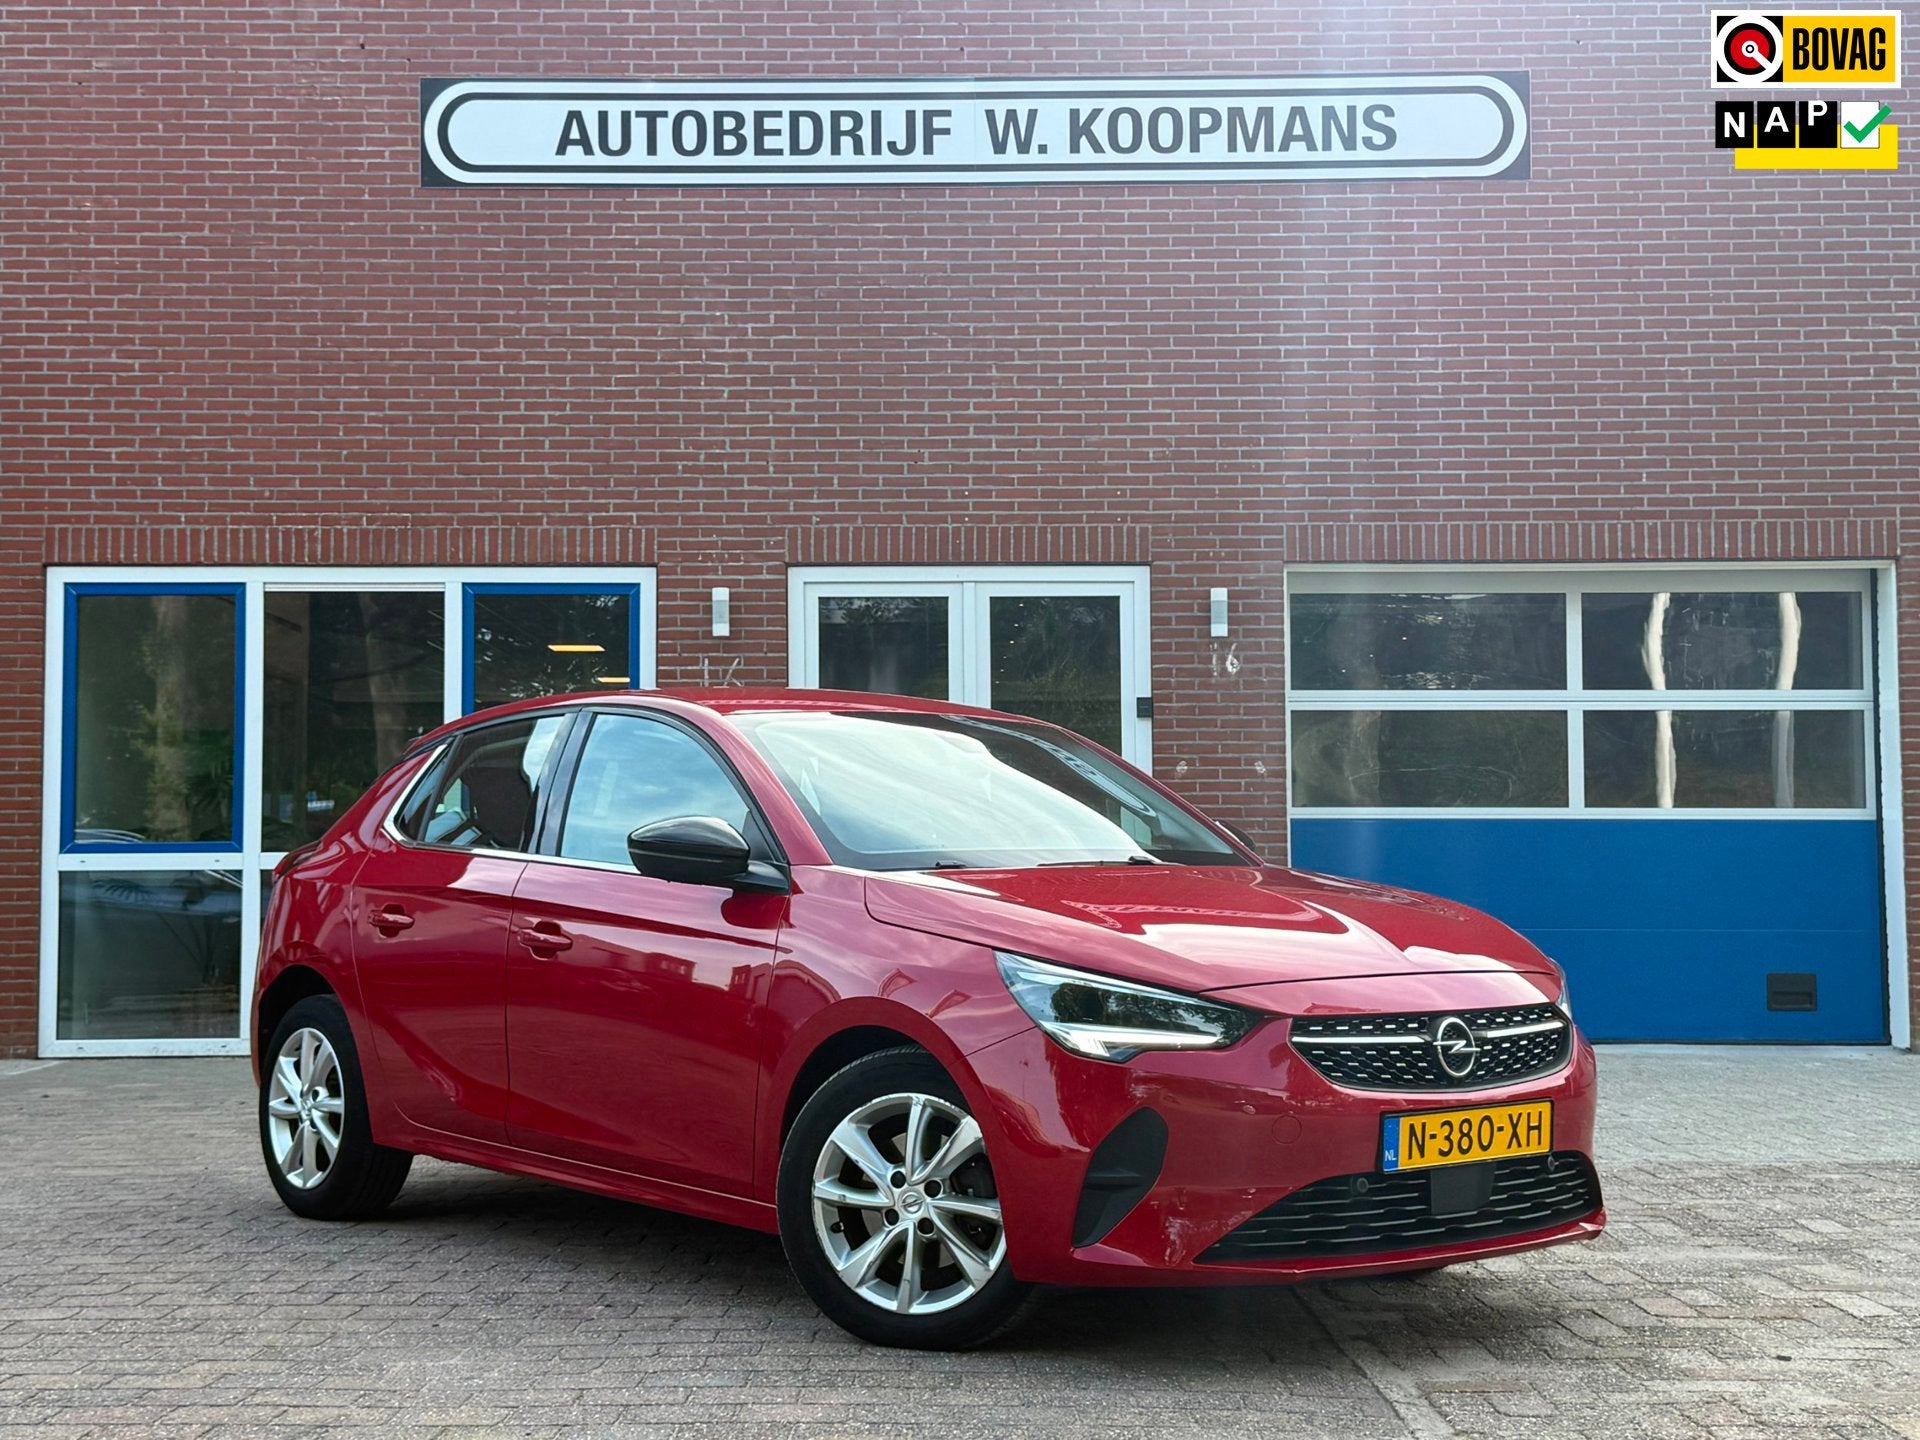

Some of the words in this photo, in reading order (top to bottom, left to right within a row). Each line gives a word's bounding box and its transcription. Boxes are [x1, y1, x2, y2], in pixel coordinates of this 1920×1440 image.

[555, 109, 952, 156] AUTOBEDRIJF
[985, 108, 1048, 155] W.
[1069, 103, 1397, 154] KOOPMANS
[1384, 1150, 1396, 1161] NL
[1408, 1111, 1543, 1160] N-380-XH
